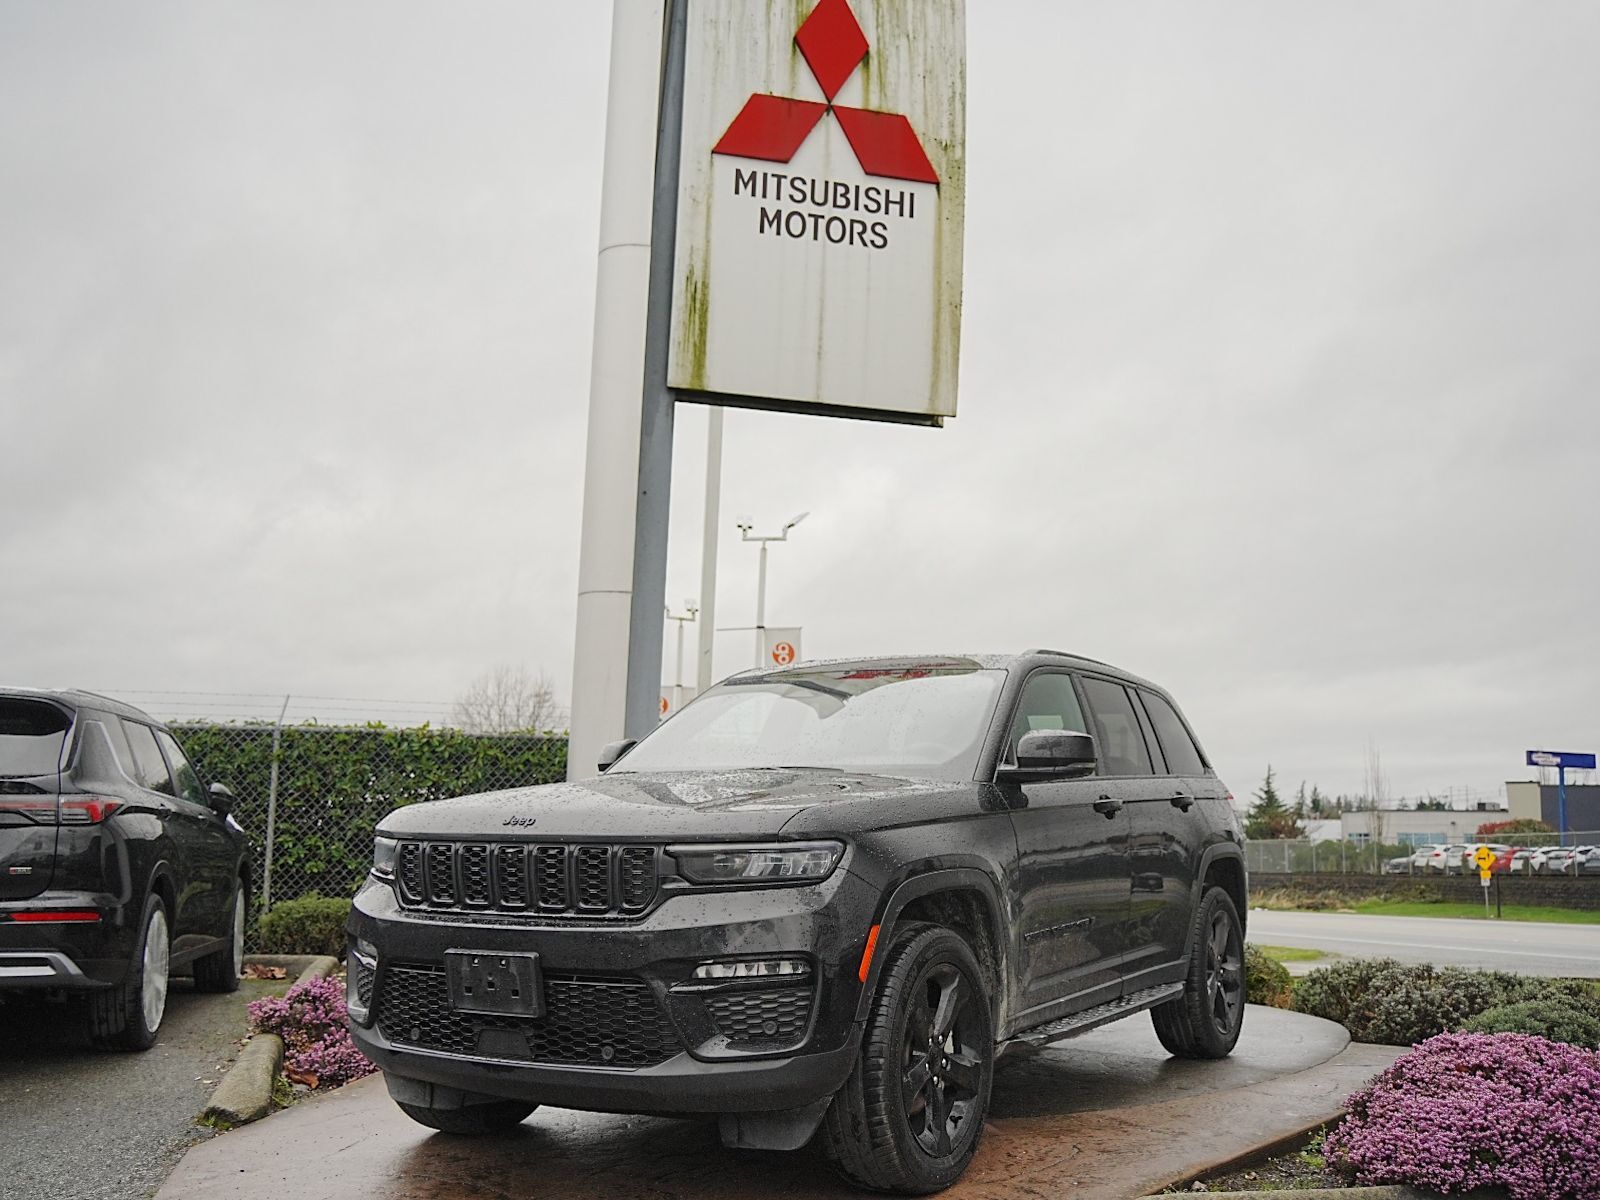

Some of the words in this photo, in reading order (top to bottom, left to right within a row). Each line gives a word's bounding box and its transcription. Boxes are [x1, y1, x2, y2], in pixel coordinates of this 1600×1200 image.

[734, 168, 915, 219] MITSUBISHI
[759, 206, 888, 250] MOTORS
[502, 815, 536, 829] Jeep
